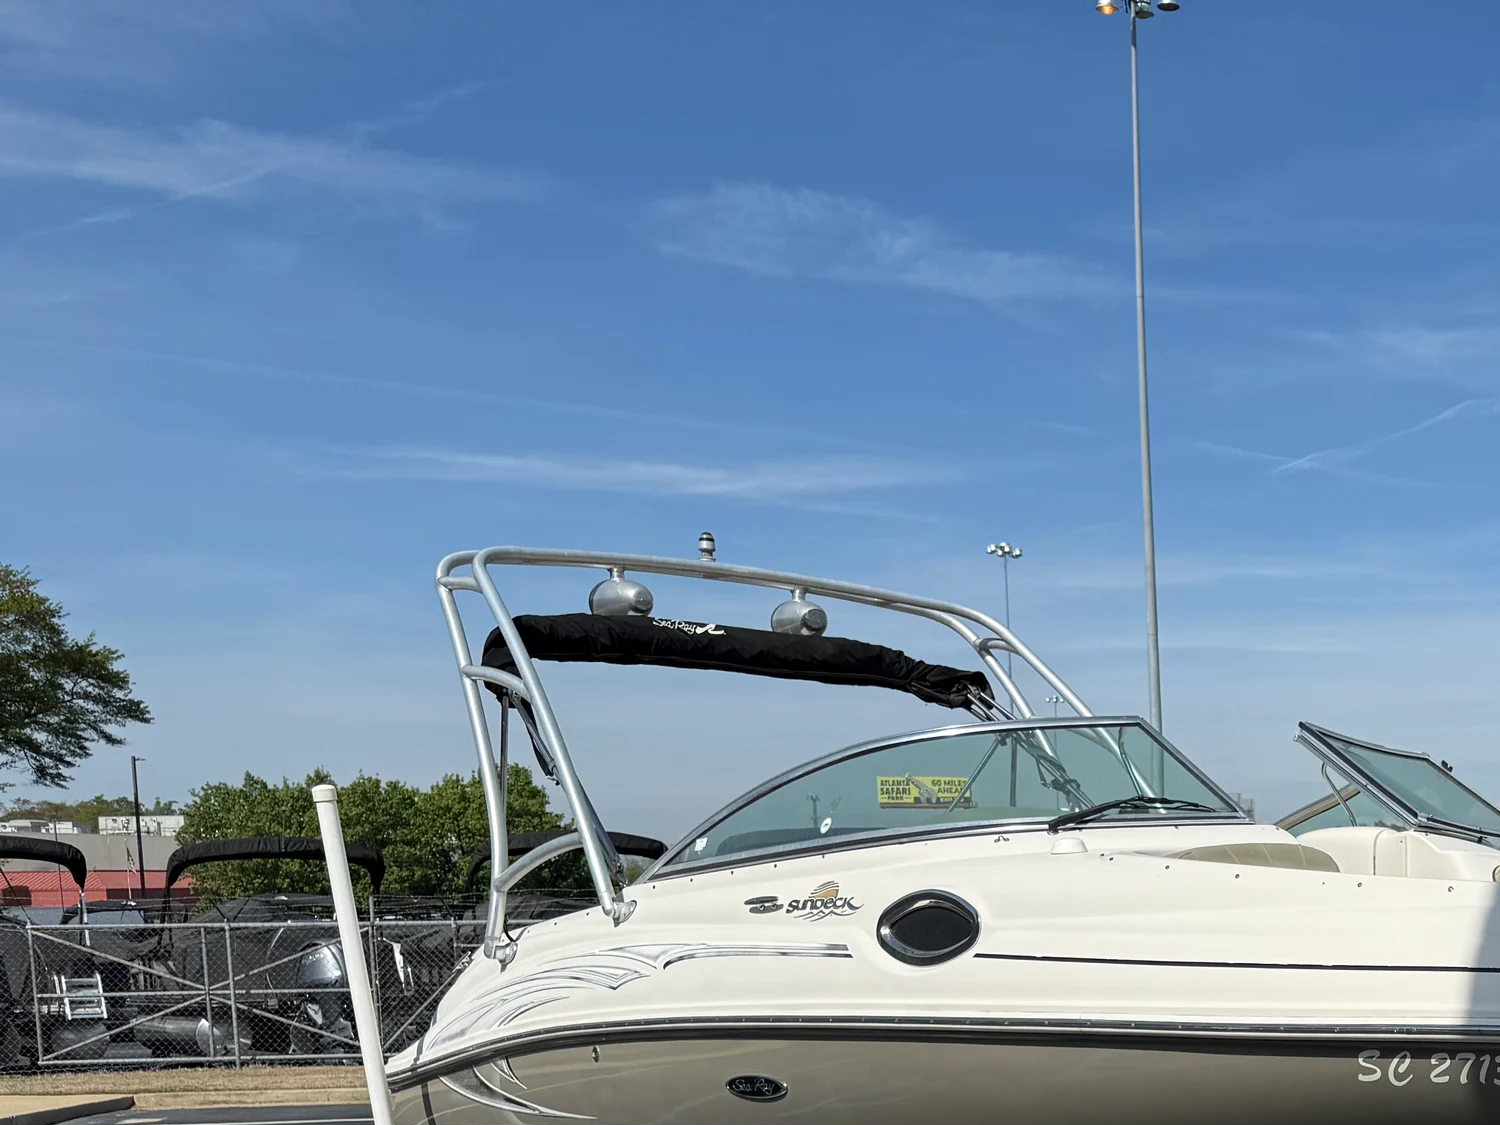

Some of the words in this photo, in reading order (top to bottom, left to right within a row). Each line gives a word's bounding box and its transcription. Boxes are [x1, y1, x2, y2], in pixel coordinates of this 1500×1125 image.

[652, 617, 675, 629] Sea
[675, 620, 697, 635] Ray
[880, 779, 910, 787] ATLANTA
[880, 787, 911, 796] SAFARI
[1357, 1049, 1414, 1087] SC
[732, 1079, 751, 1092] Sea
[754, 1078, 775, 1096] Ray
